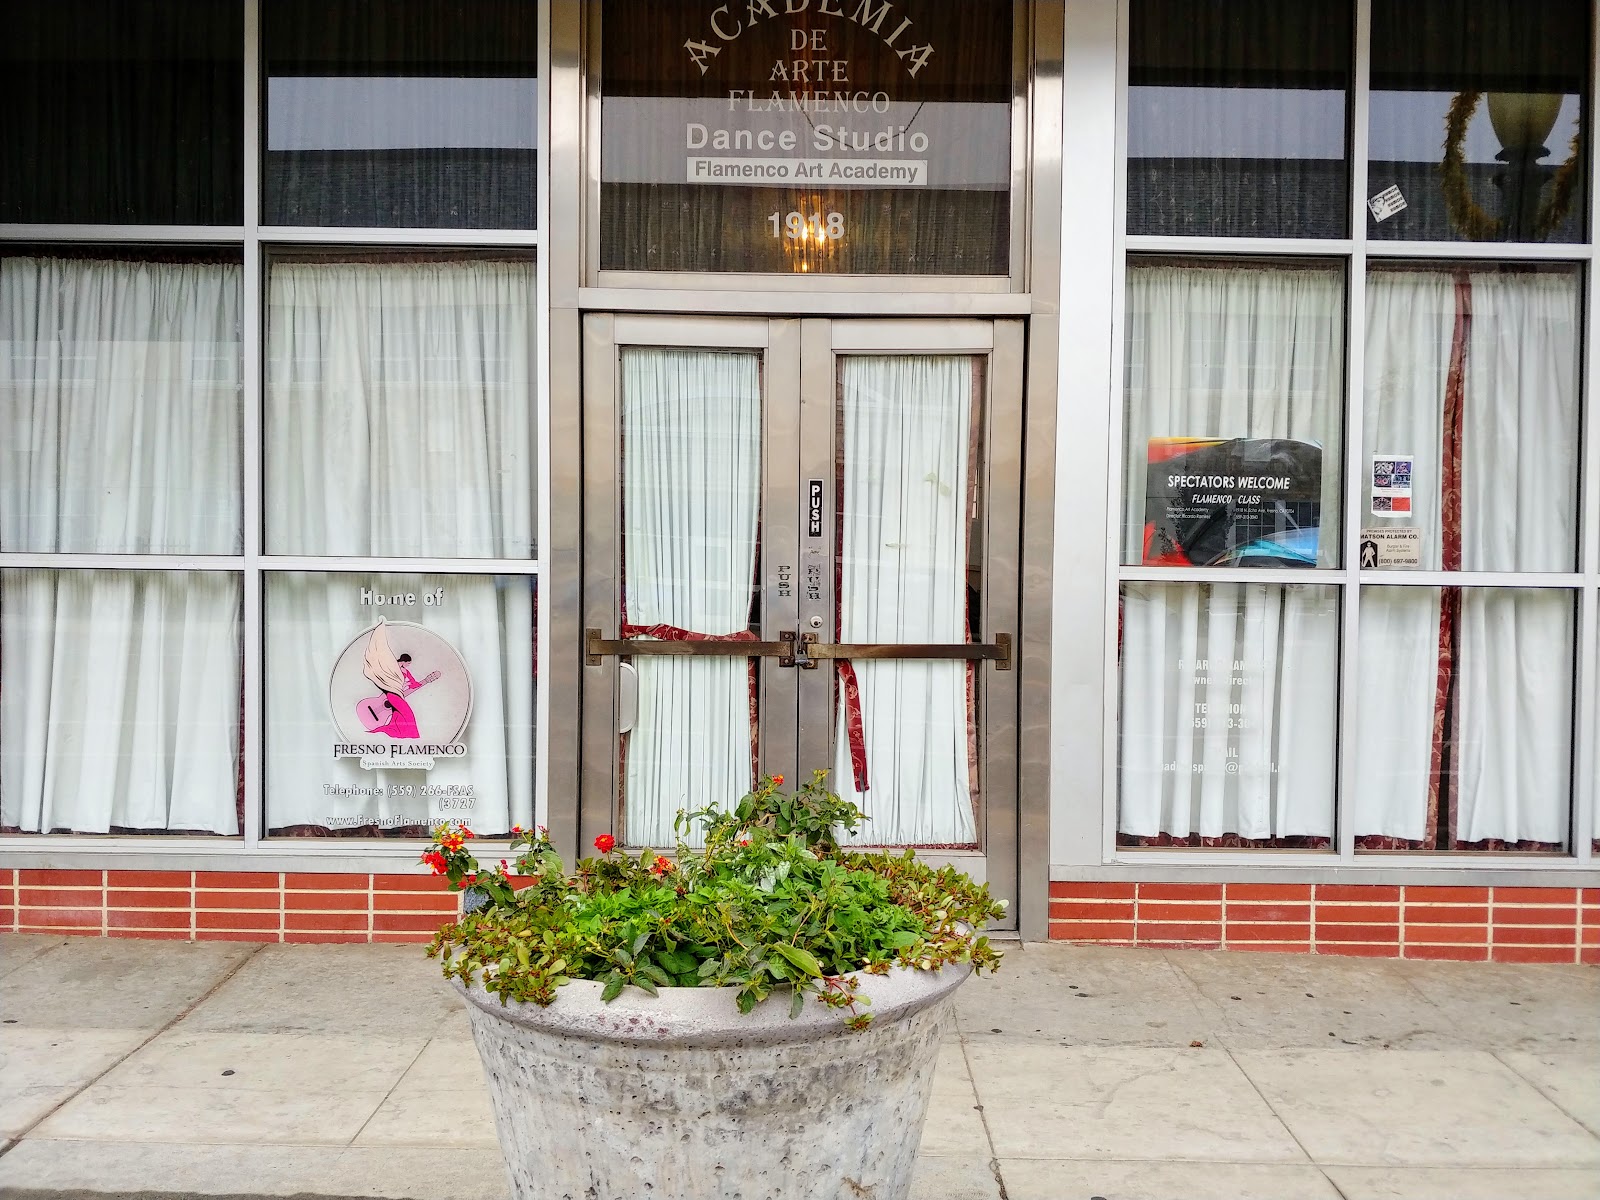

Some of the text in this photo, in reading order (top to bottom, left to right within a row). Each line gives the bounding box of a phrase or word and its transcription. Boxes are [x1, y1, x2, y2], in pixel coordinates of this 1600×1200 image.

[790, 29, 828, 51] DE
[768, 60, 849, 83] ARTE
[728, 90, 890, 113] FLAMENCO
[686, 122, 929, 153] Dance Studio
[695, 160, 918, 183] Flamenco Art Academy
[768, 211, 845, 240] 1918
[1167, 475, 1290, 490] SPECTATORS WELCOME
[811, 484, 821, 533] PUSH
[1191, 494, 1261, 505] FLAMENCO CLASS
[360, 587, 444, 606] Home of
[333, 744, 465, 758] FRESNO FLAMENCO
[362, 760, 389, 768] Spanish
[408, 760, 433, 768] Society
[323, 784, 474, 798] Telephone: (559) 266-FSAS
[326, 815, 472, 826] www.FresnoFlamencocom
